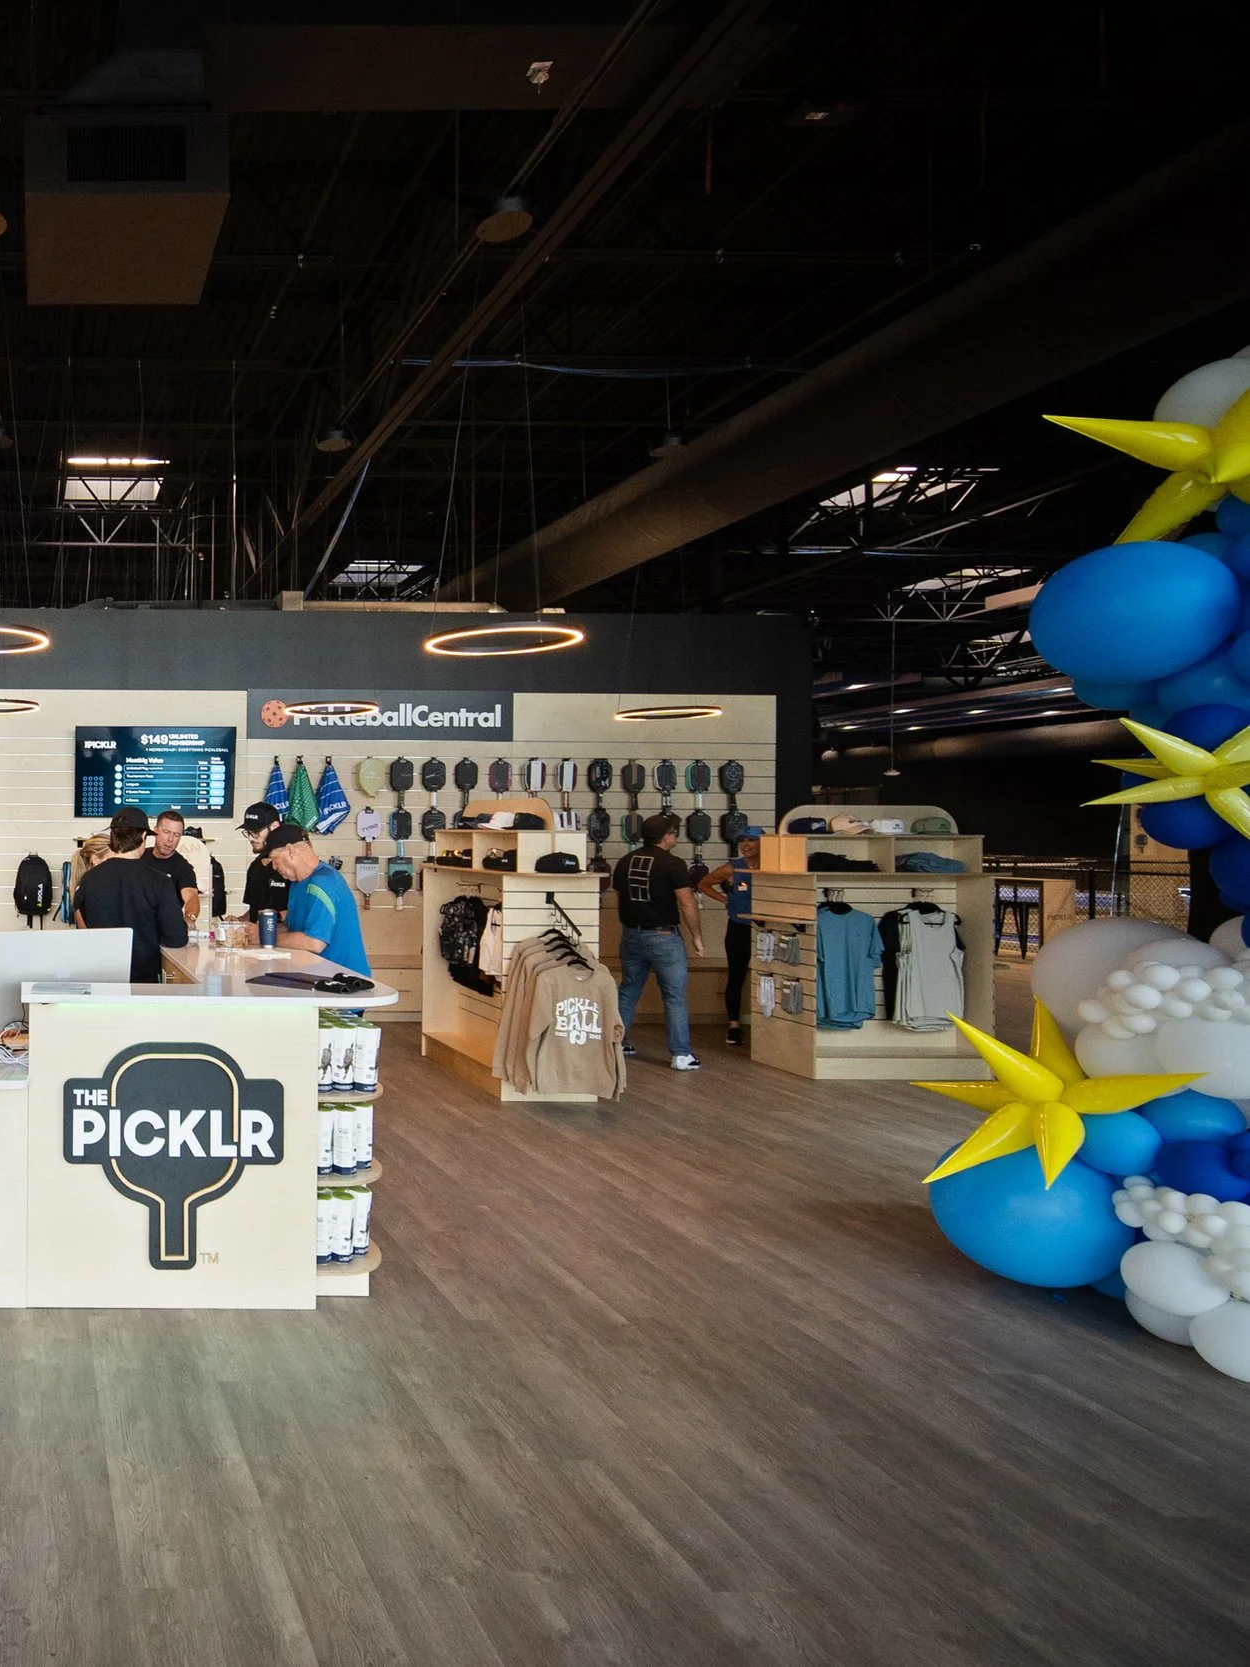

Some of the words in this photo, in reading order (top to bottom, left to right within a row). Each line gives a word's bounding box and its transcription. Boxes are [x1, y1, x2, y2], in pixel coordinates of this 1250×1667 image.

[293, 703, 502, 728] PickleballCentral
[87, 741, 117, 749] PICKLR
[140, 734, 169, 746] $149
[555, 997, 599, 1015] PICKLE
[555, 1011, 602, 1033] BALL
[73, 1089, 108, 1106] THE
[72, 1109, 276, 1158] PICKLR
